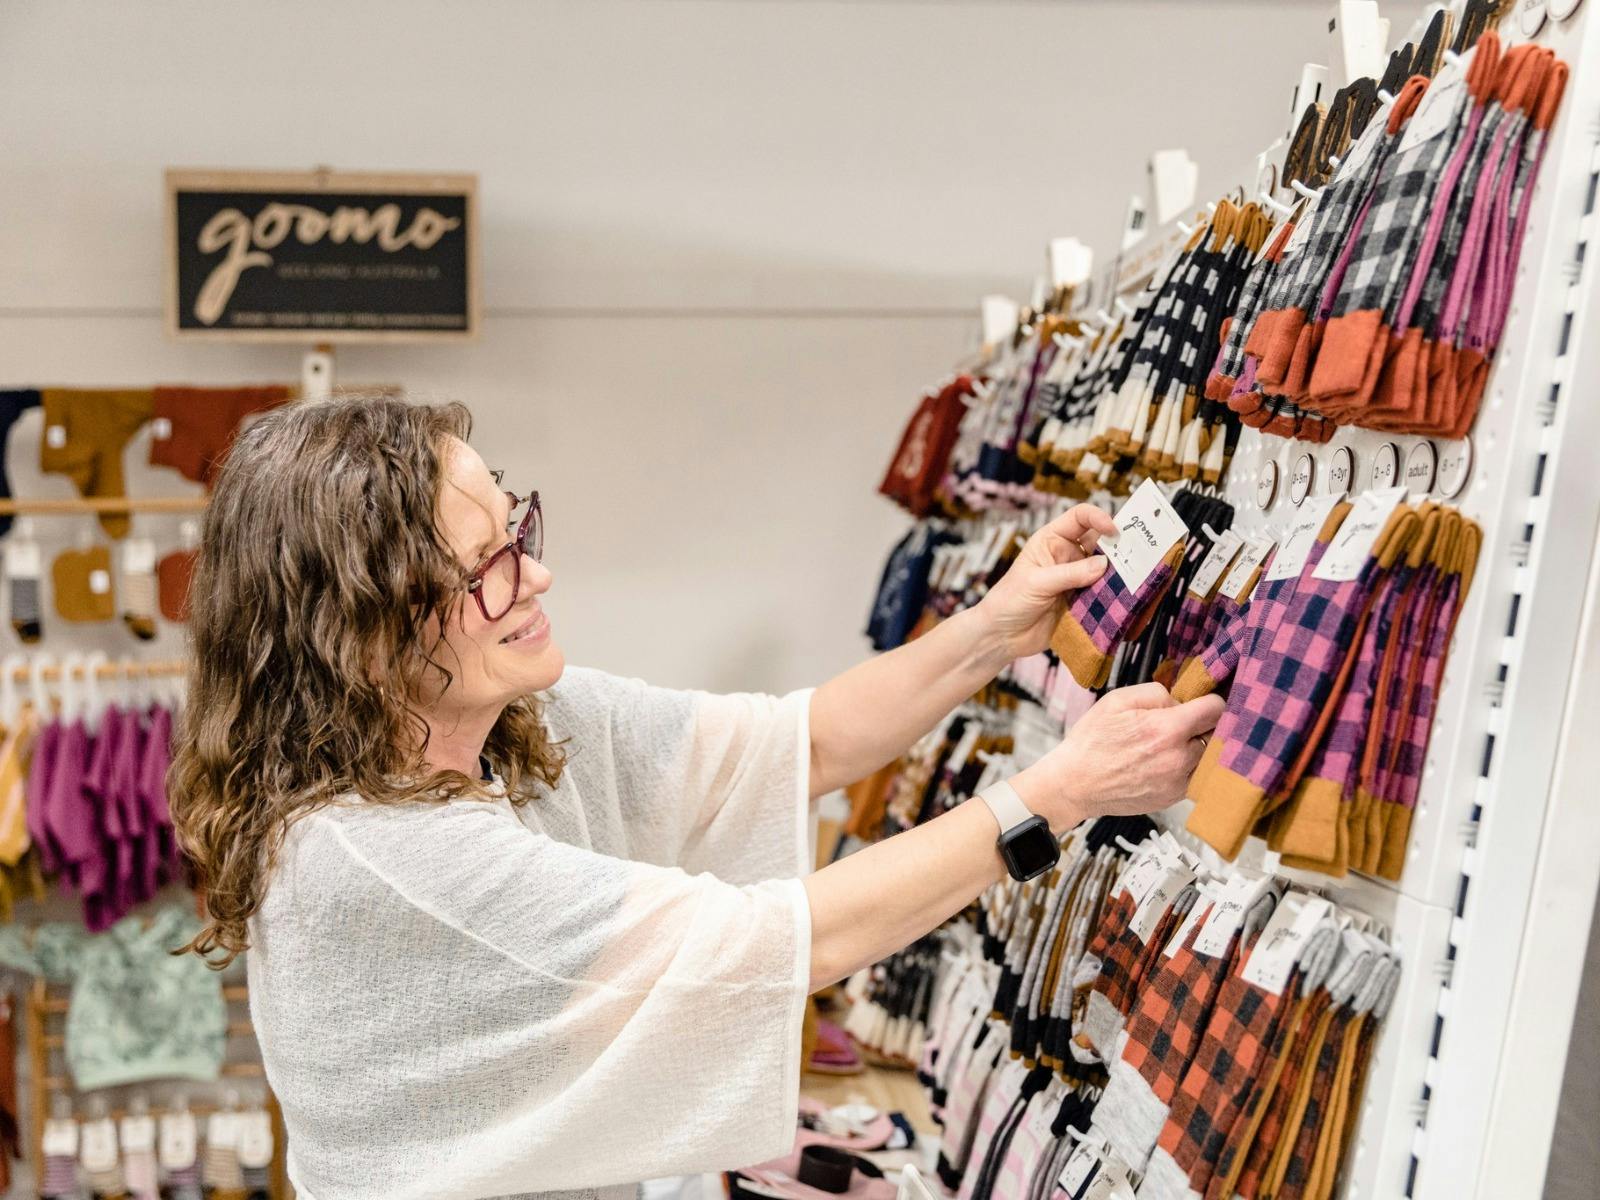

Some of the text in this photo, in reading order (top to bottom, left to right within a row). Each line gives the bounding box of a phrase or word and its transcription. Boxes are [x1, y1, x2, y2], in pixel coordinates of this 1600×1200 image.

[193, 201, 461, 325] goomo
[1408, 463, 1429, 478] adult
[1123, 516, 1159, 547] goomo
